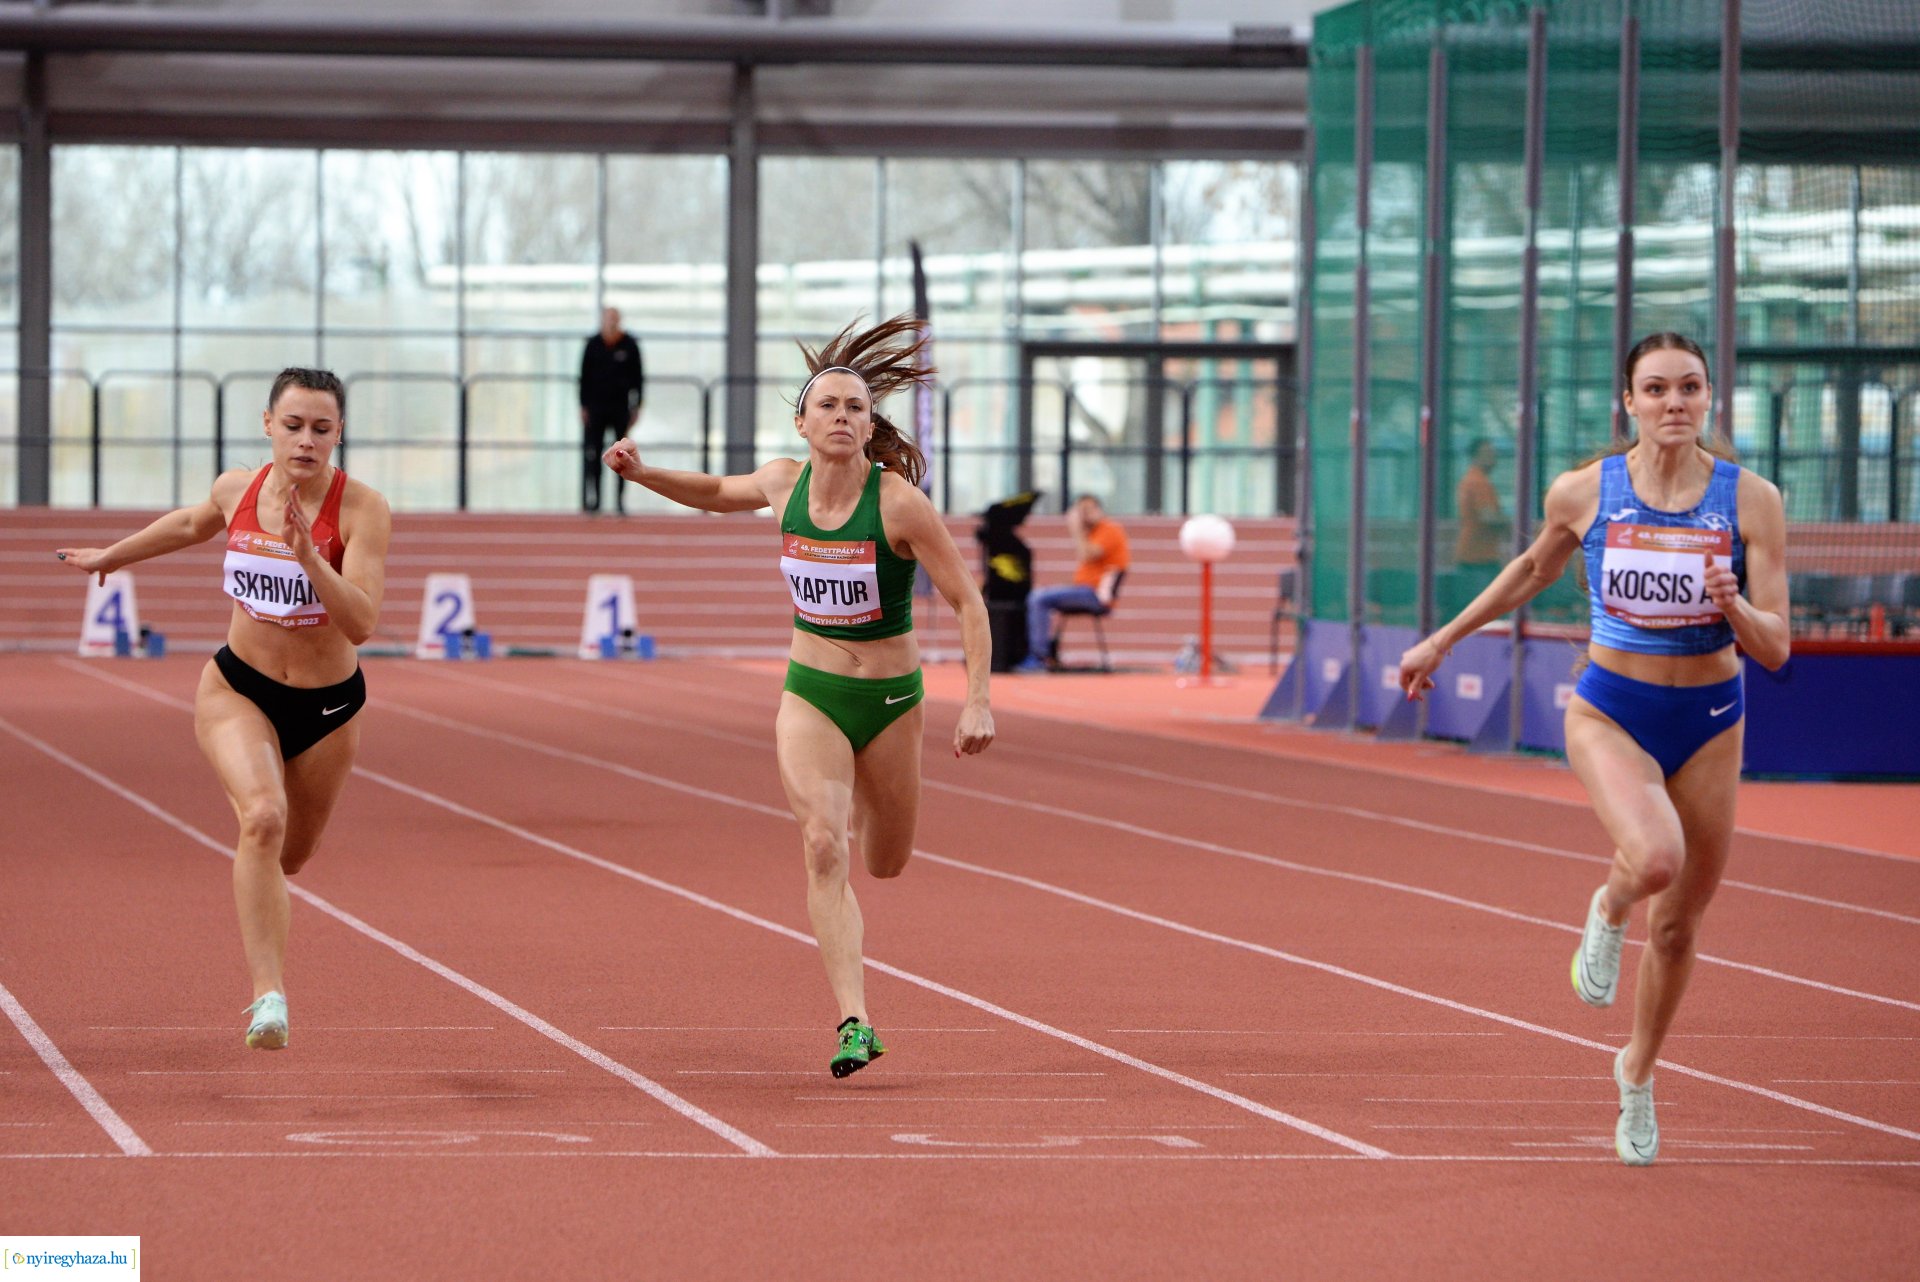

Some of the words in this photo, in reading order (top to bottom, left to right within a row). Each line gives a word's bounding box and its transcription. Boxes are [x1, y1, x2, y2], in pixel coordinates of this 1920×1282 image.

[810, 546, 865, 555] FEDETTPÁLYÁS
[232, 569, 320, 606] SKRIVÁN
[789, 574, 869, 606] KAPTUR
[1608, 568, 1694, 604] KOCSIS
[97, 591, 127, 635] 4
[297, 617, 320, 625] 2023
[435, 592, 462, 636] 2
[600, 594, 620, 636] 1
[851, 615, 872, 625] 2023
